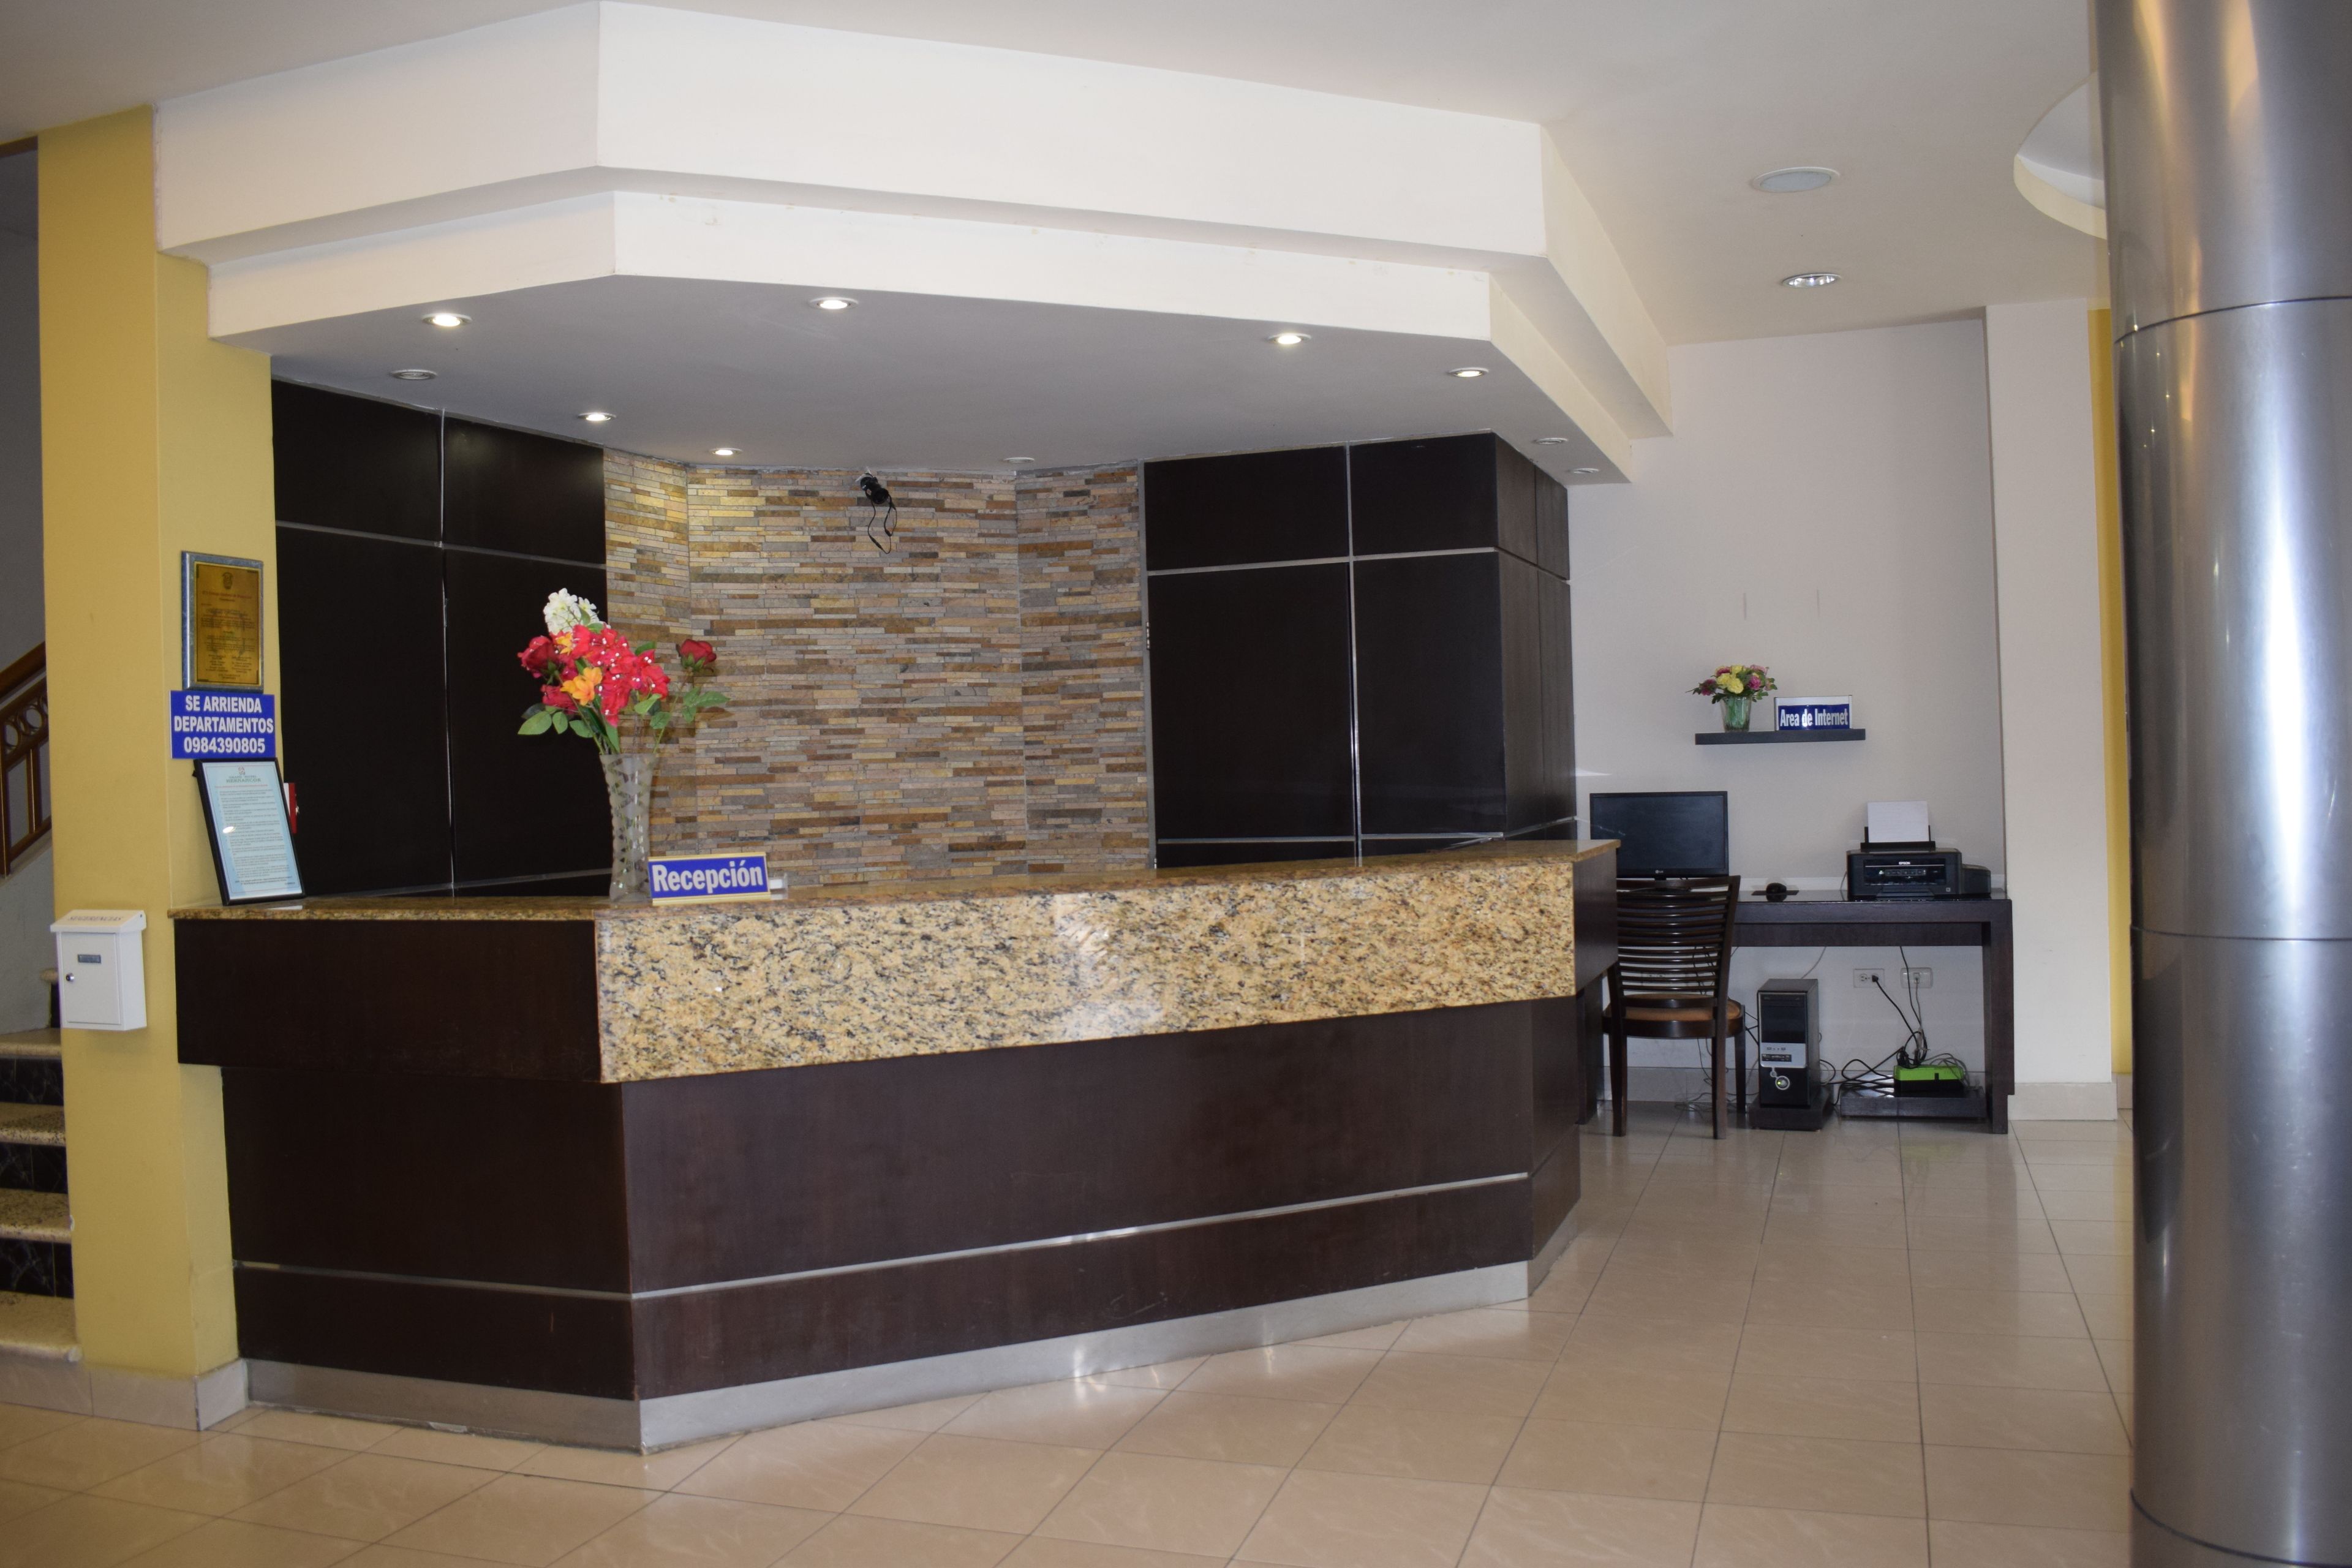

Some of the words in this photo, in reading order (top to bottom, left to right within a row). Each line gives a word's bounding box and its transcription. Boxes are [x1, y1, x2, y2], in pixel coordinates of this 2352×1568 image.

[185, 695, 200, 712] SE
[203, 696, 262, 713] ARRIENDA
[174, 715, 274, 733] DEPARTAMENTOS
[1780, 709, 1800, 727] Area
[1803, 709, 1812, 727] de
[1815, 708, 1848, 726] Internet
[183, 736, 266, 753] 0984390805
[652, 860, 763, 894] Recepción
